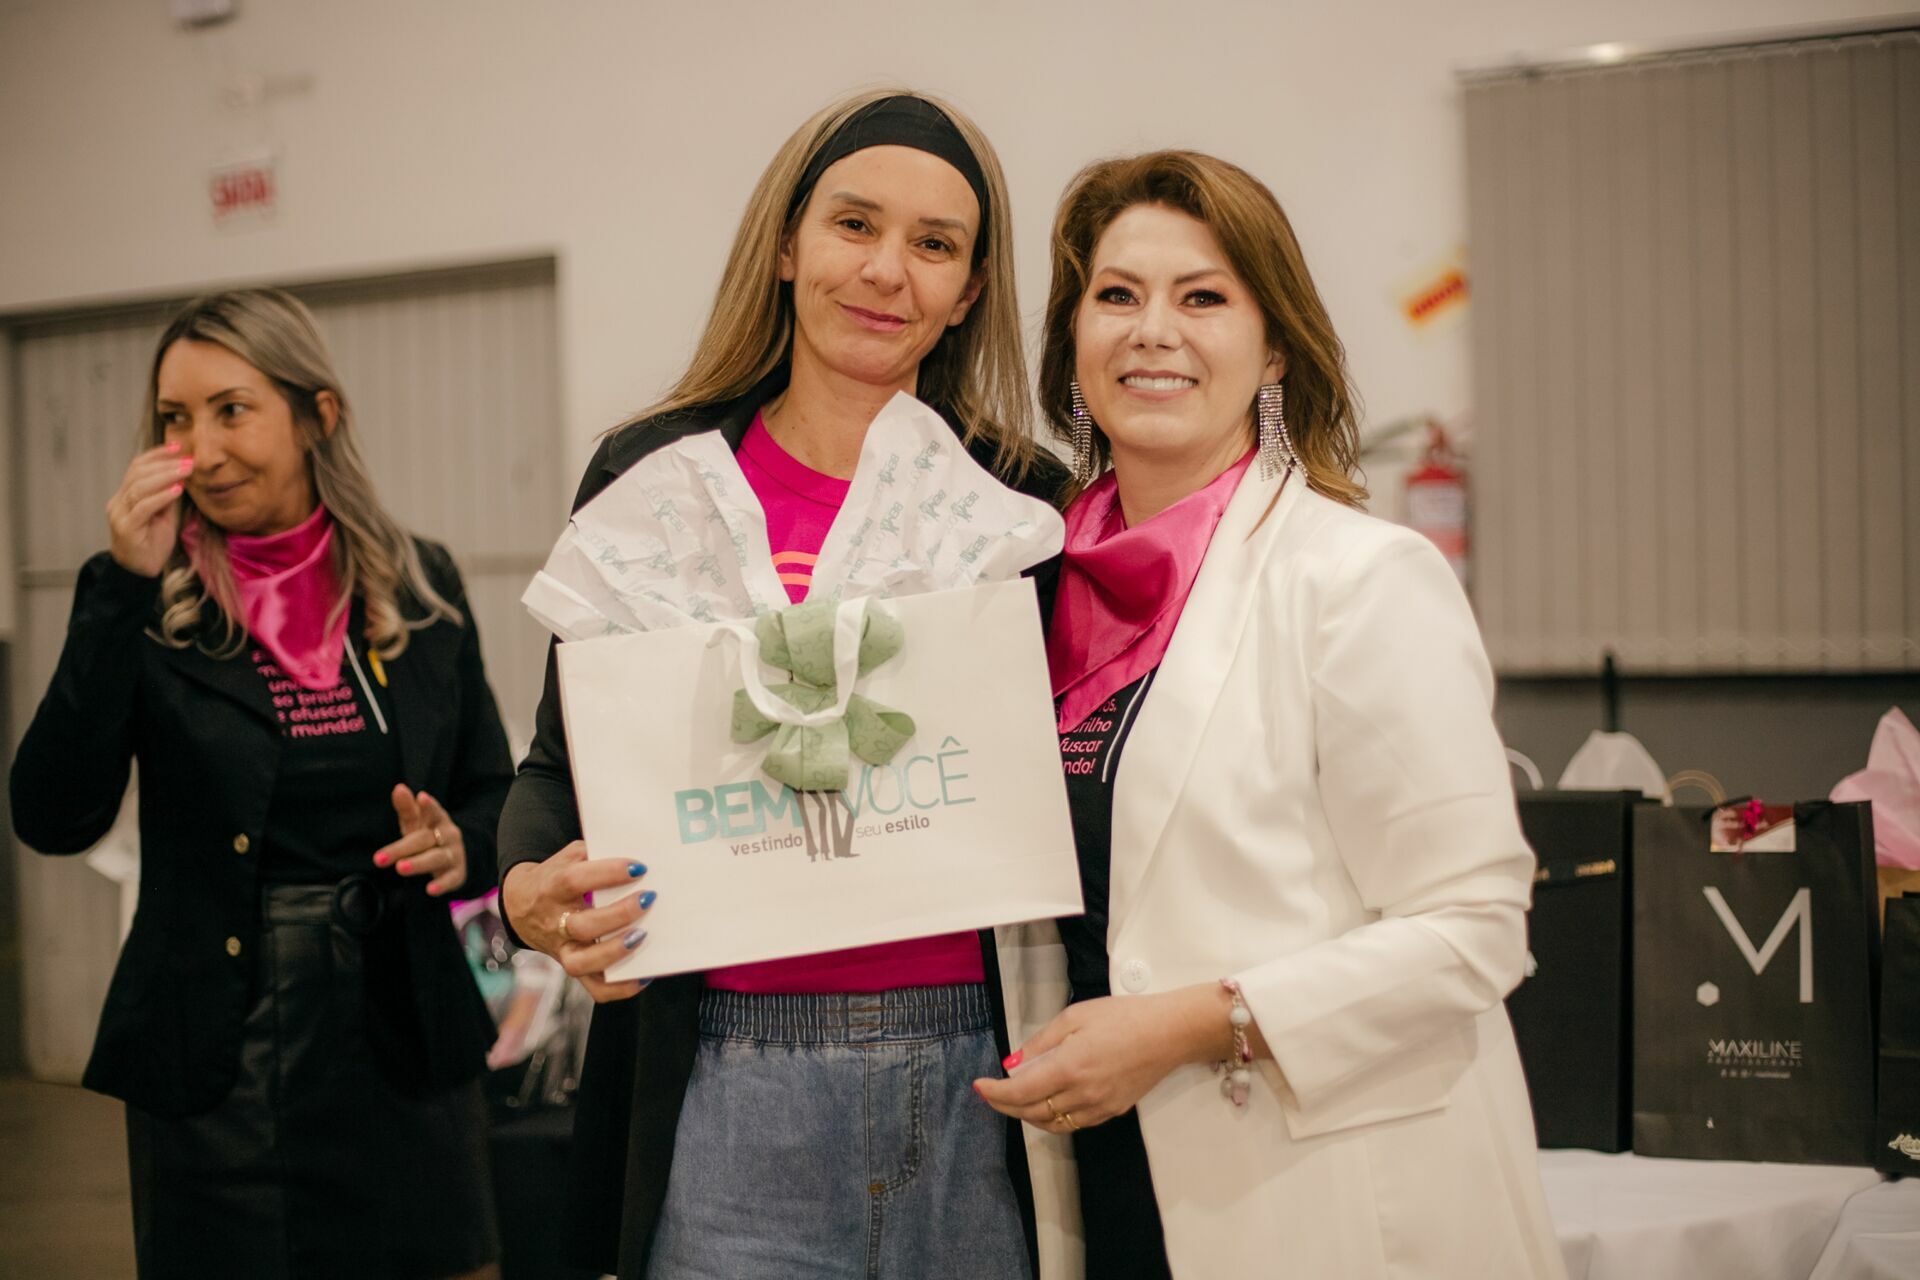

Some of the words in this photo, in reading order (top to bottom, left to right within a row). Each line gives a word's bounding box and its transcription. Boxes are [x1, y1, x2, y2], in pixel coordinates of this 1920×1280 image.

[1060, 737, 1103, 753] fuscar
[1063, 757, 1096, 774] ndo!
[674, 779, 803, 844] BEM
[841, 735, 976, 820] VOCÊ
[731, 833, 803, 857] vestindo
[855, 822, 882, 838] seu
[885, 814, 930, 835] estilo
[1708, 1038, 1803, 1059] MAXILINE
